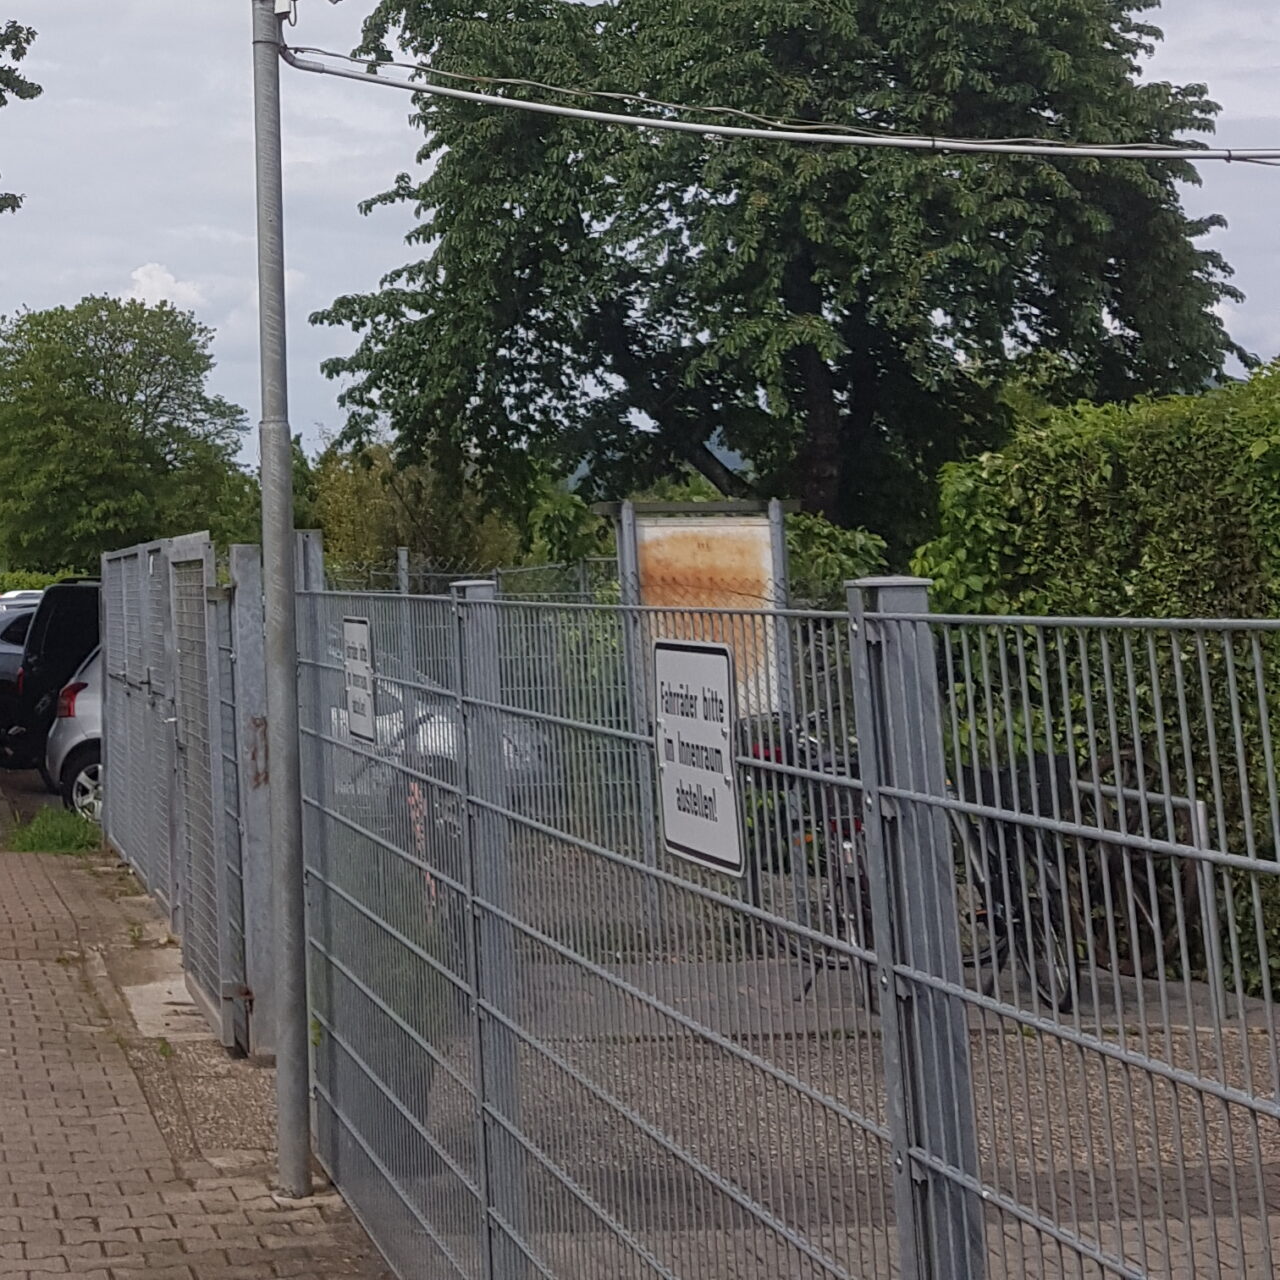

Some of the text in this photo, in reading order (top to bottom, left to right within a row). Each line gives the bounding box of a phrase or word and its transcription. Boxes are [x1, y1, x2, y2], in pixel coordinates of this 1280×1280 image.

[660, 680, 725, 724] Fahrräder bitte
[677, 730, 724, 775] Innenraum
[675, 778, 719, 823] abstellen!
